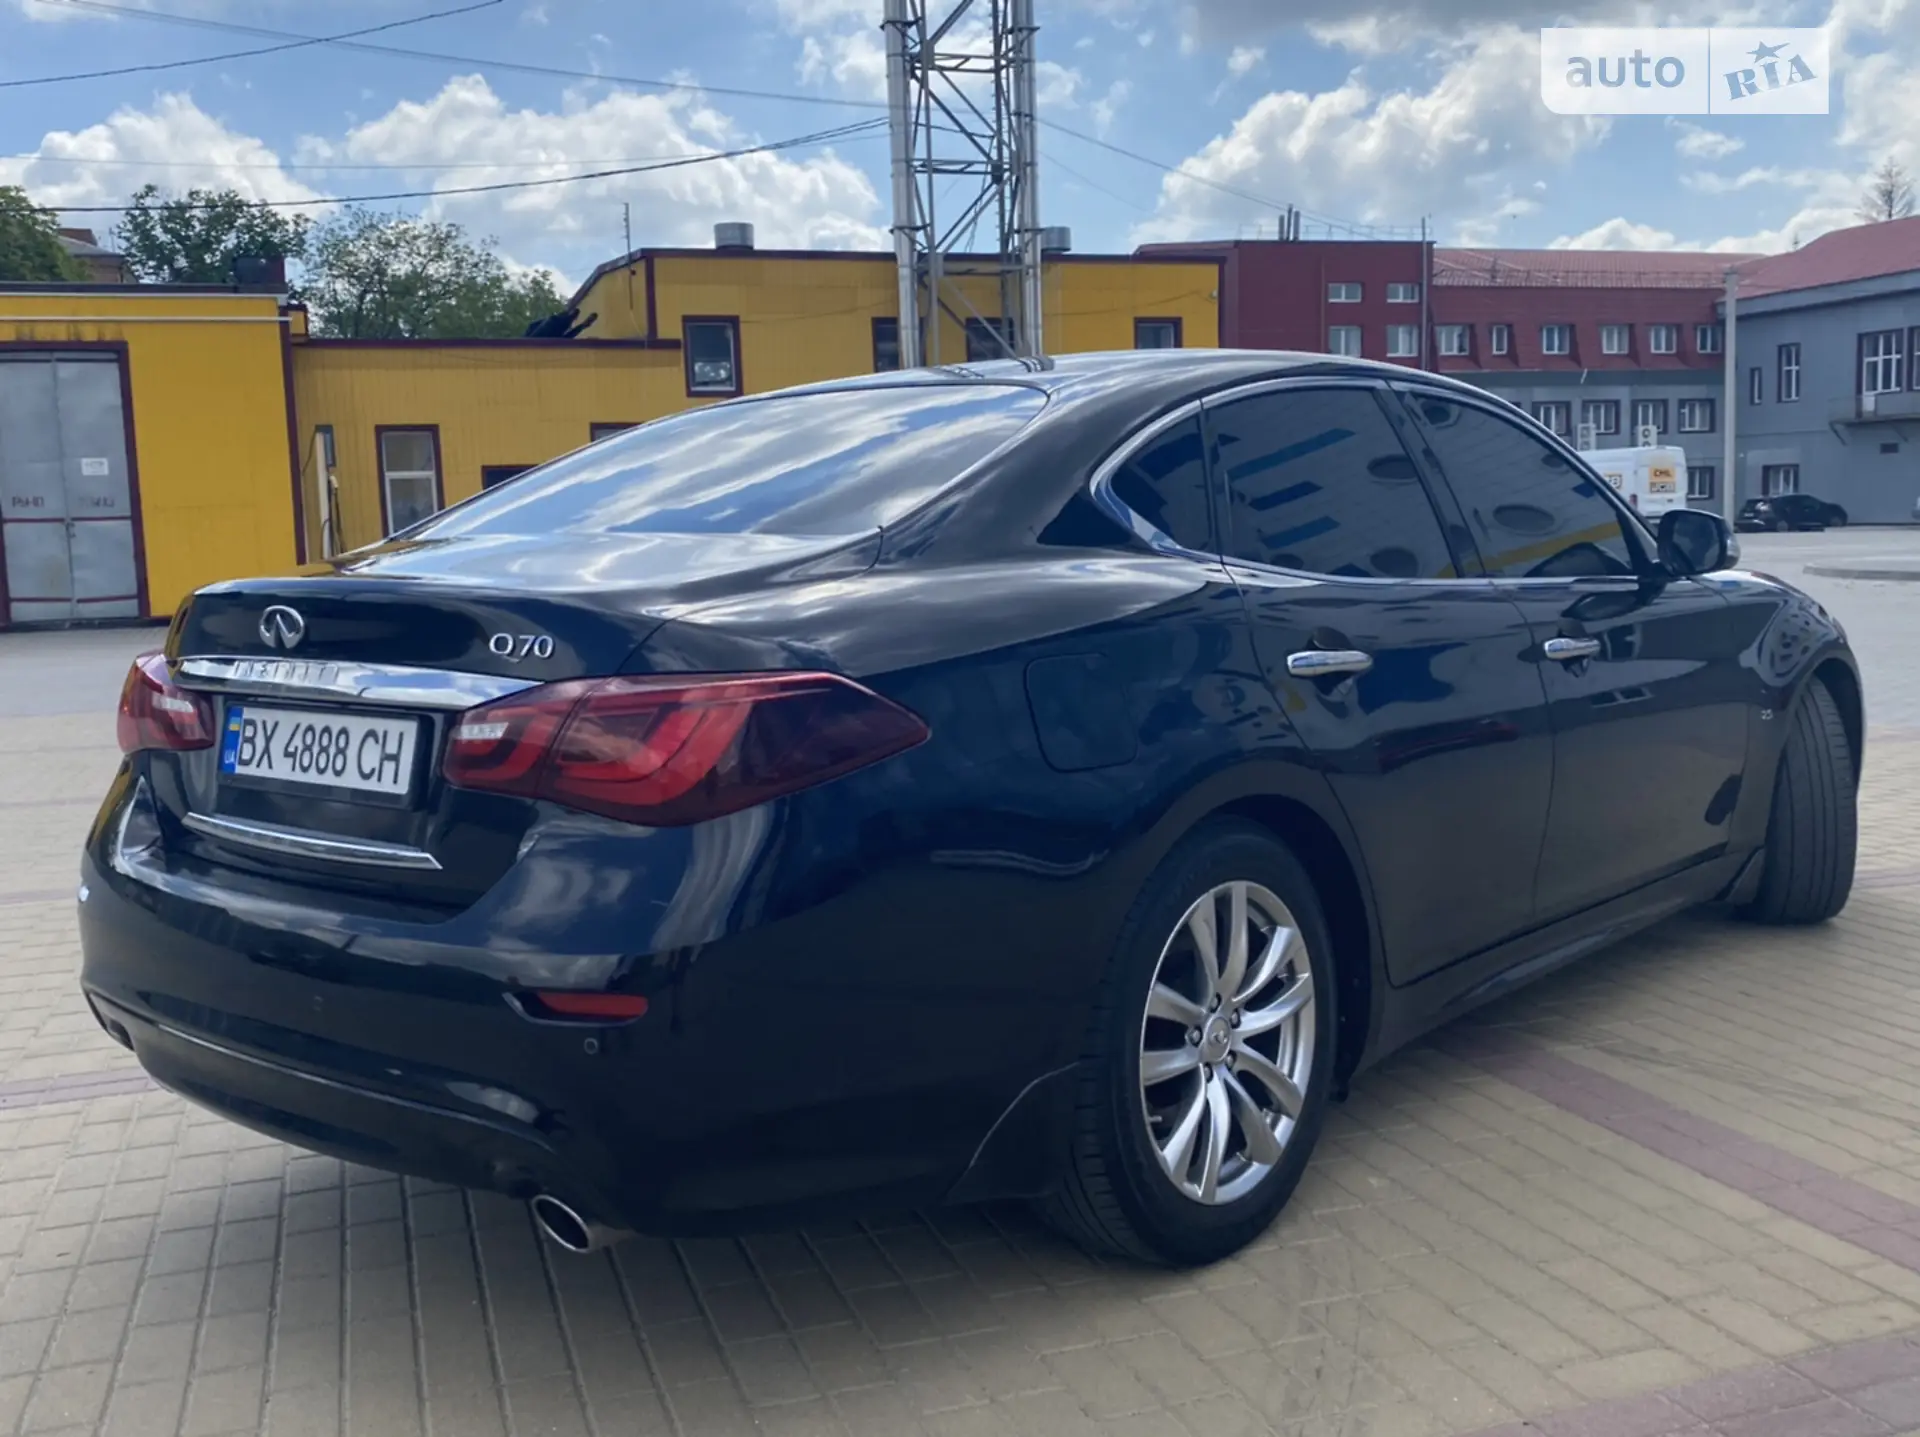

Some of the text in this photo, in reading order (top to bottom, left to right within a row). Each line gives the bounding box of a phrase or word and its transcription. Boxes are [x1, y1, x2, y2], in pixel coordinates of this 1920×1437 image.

[488, 632, 554, 663] Q70
[238, 717, 404, 785] BX 4888 CH
